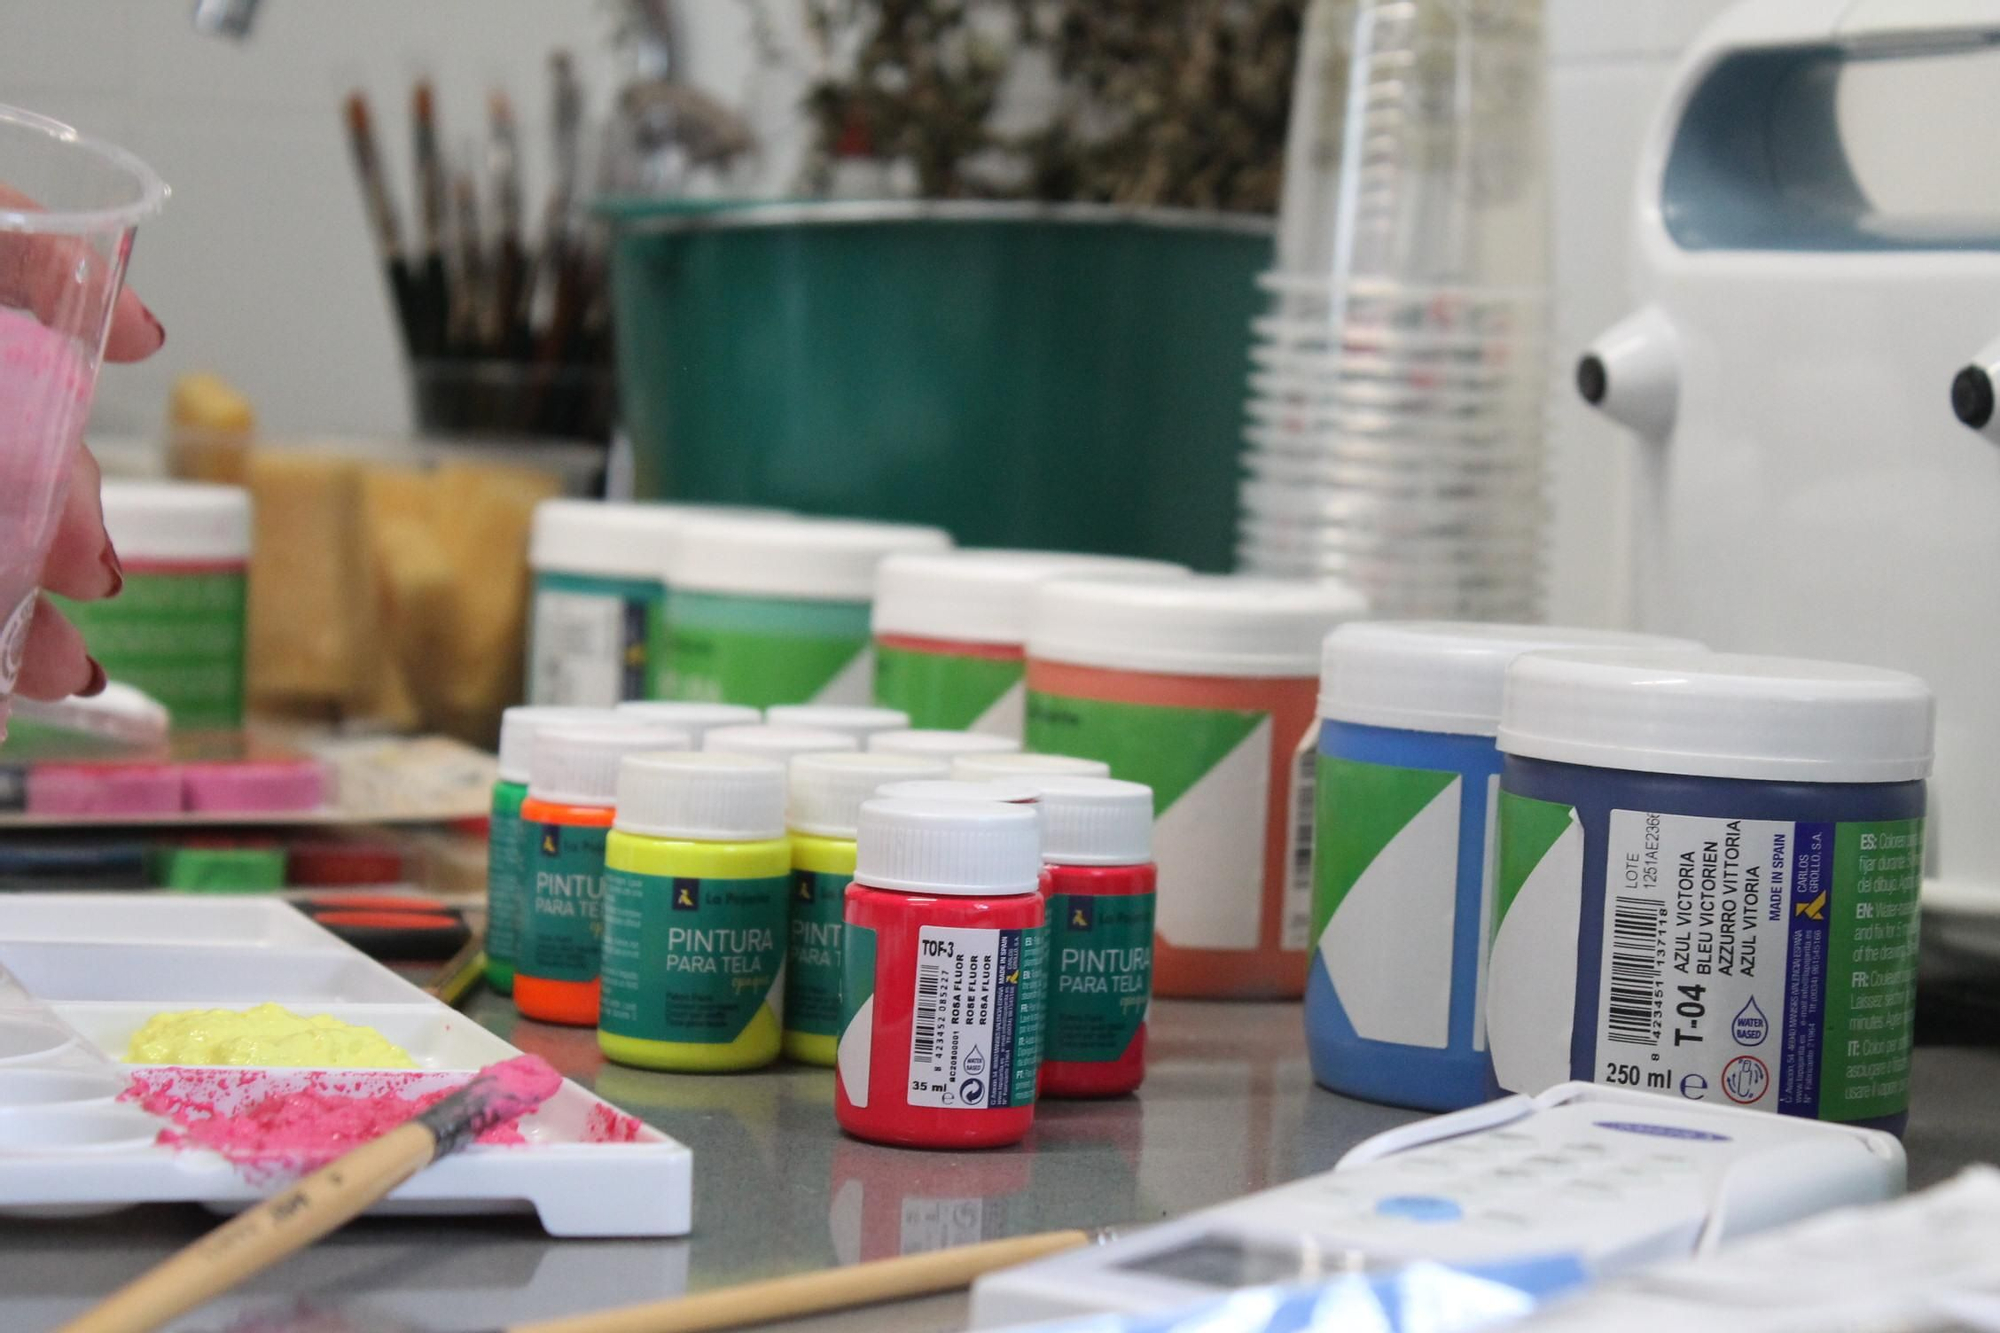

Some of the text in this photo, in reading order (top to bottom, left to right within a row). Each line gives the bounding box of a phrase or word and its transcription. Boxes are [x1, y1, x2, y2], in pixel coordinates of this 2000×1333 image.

[1860, 833, 1877, 850] ES:
[1625, 852, 1640, 889] LOTE
[1769, 833, 1786, 921] MADE IN SPAIN
[1796, 854, 1809, 893] CARLOS
[536, 871, 605, 899] PINTU
[1718, 820, 1742, 976] AZZURRO VITTORIA
[535, 896, 600, 918] PARA TE
[1674, 851, 1696, 974] AZUL VICTORIA
[1696, 841, 1718, 975] BLEU VICTORIEN
[1740, 865, 1761, 977] AZUL VITORIA
[1856, 902, 1874, 919] EN:
[667, 927, 774, 953] PINTURA
[792, 919, 842, 947] PINT
[922, 939, 955, 958] TOF-3
[666, 953, 762, 974] PARA TELA
[939, 970, 950, 1012] 085227
[951, 953, 965, 1025] ROSA FLUOR
[966, 954, 979, 1025] ROSE FLUOR
[979, 954, 992, 1025] ROSA FLUOR
[1059, 975, 1108, 993] PARA
[1111, 974, 1143, 993] TELA
[1651, 908, 1668, 1062] 8 423451 137118
[1851, 971, 1869, 988] FR:
[1674, 984, 1706, 1046] T-04
[1736, 1017, 1764, 1028] WATER
[935, 1017, 946, 1059] 423452
[1736, 1029, 1762, 1040] BASED
[1848, 1040, 1860, 1057] IT:
[912, 1081, 947, 1092] 35 ml
[1606, 1062, 1672, 1089] 250 ml
